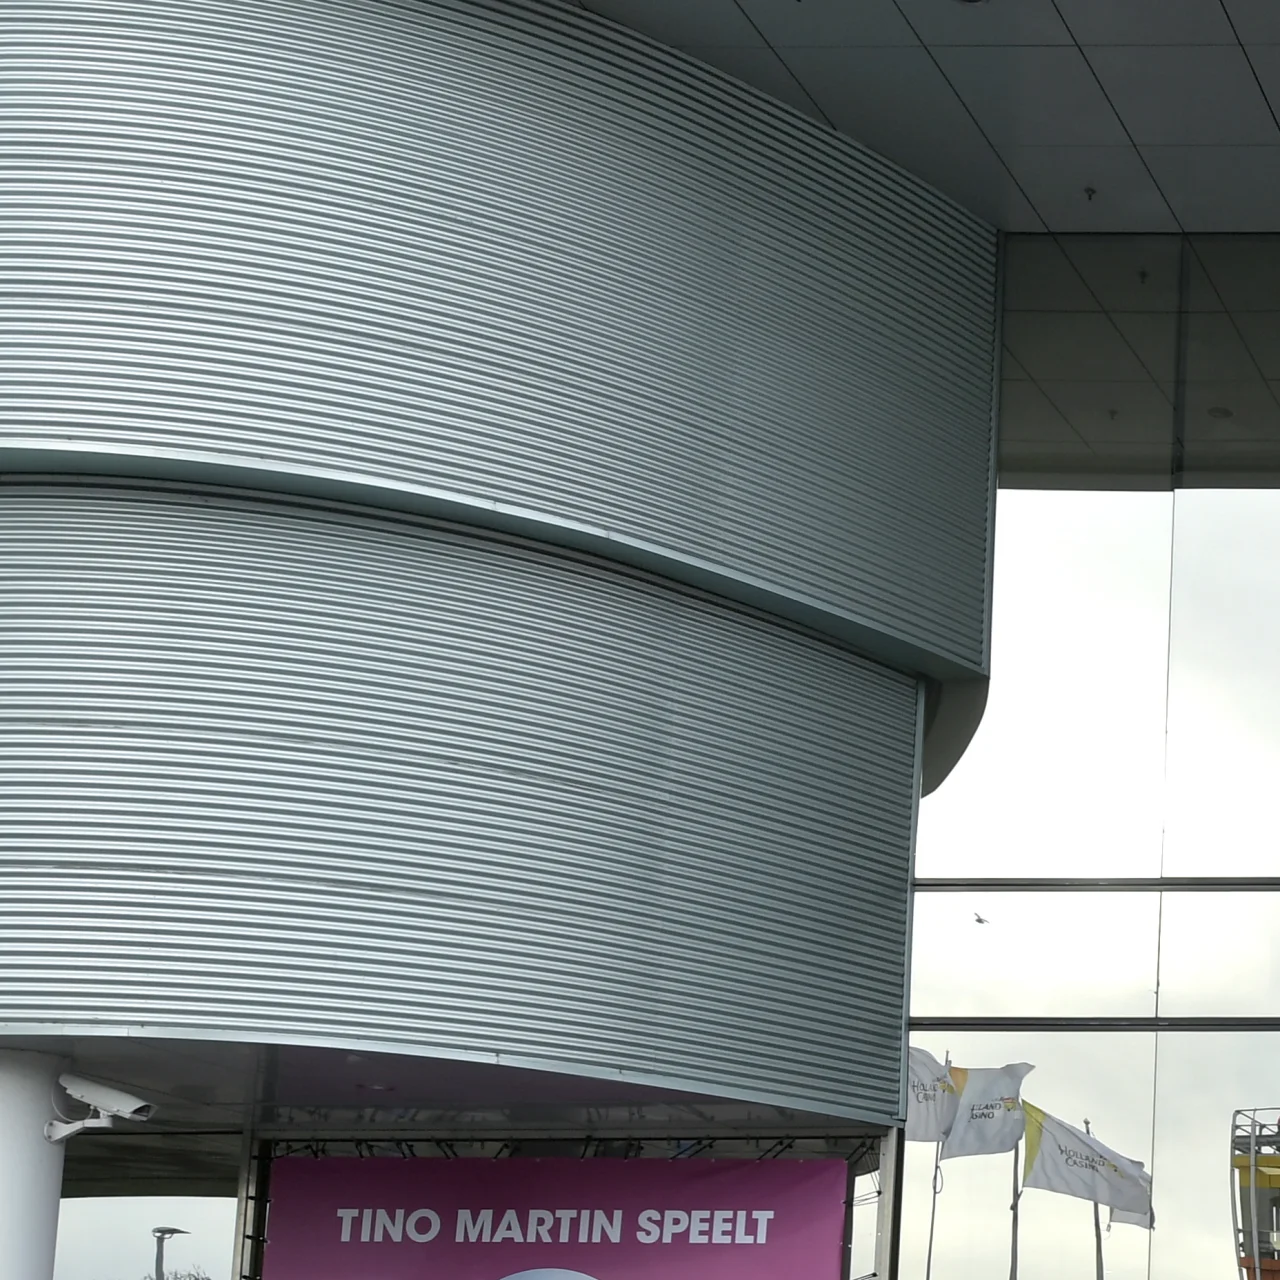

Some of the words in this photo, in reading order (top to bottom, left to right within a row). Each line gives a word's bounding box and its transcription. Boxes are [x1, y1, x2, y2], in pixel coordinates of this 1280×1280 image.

[337, 1209, 440, 1243] TINO
[455, 1209, 622, 1243] MARTIN
[636, 1210, 774, 1244] SPEELT
